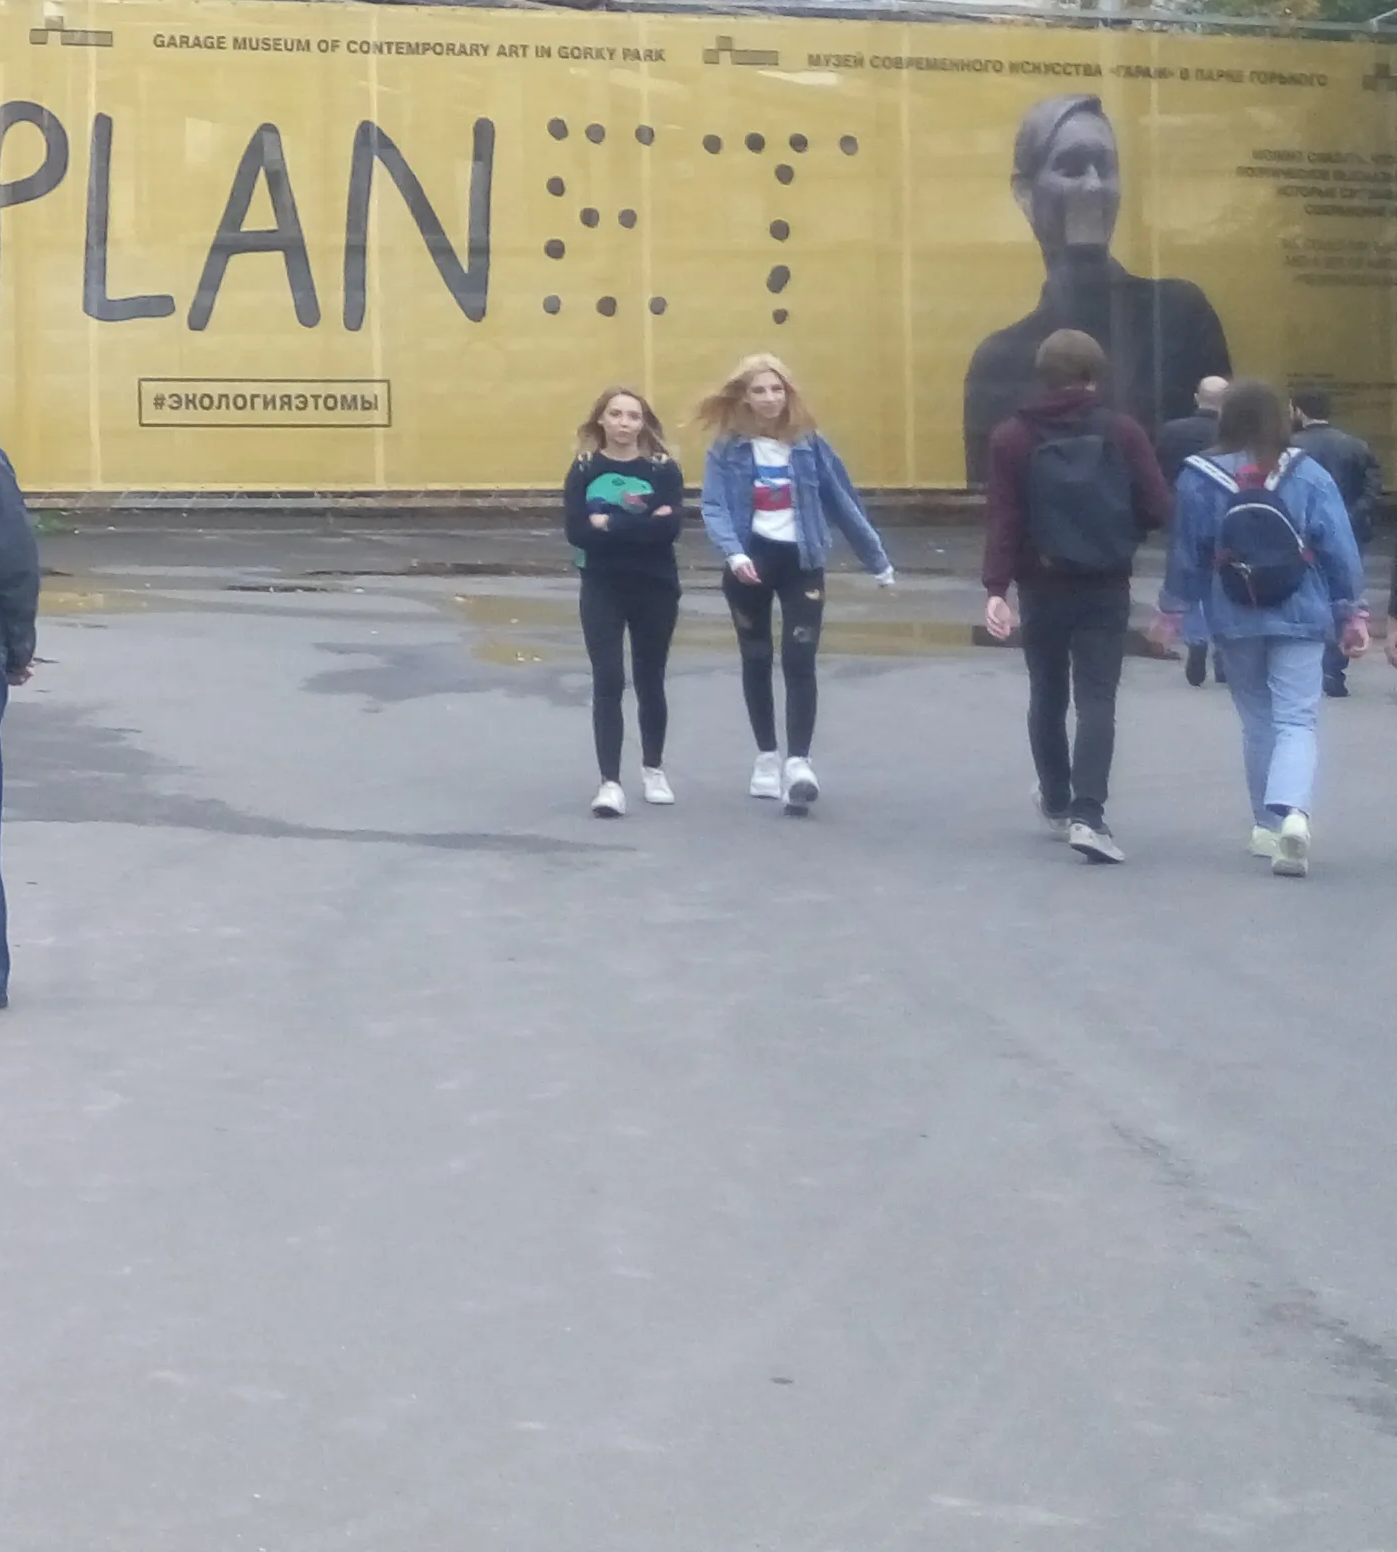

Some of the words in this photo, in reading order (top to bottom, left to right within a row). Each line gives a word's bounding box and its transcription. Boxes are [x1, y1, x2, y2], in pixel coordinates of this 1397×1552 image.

[153, 33, 227, 50] GARAGE
[232, 36, 312, 53] MUSEUM
[317, 39, 341, 53] OF
[346, 40, 490, 58] CONTEMPORARY
[496, 44, 530, 58] ART
[535, 45, 552, 58] IN
[558, 46, 616, 62] GORKY
[622, 48, 666, 63] PARK
[807, 51, 865, 69] МУЗЕЙ
[869, 54, 1004, 73] СОВРЕМЕННОГО
[1008, 61, 1103, 78] ИСКУССТВА
[153, 392, 379, 412] #ЭКОЛОГИЯЭТОМЫ
